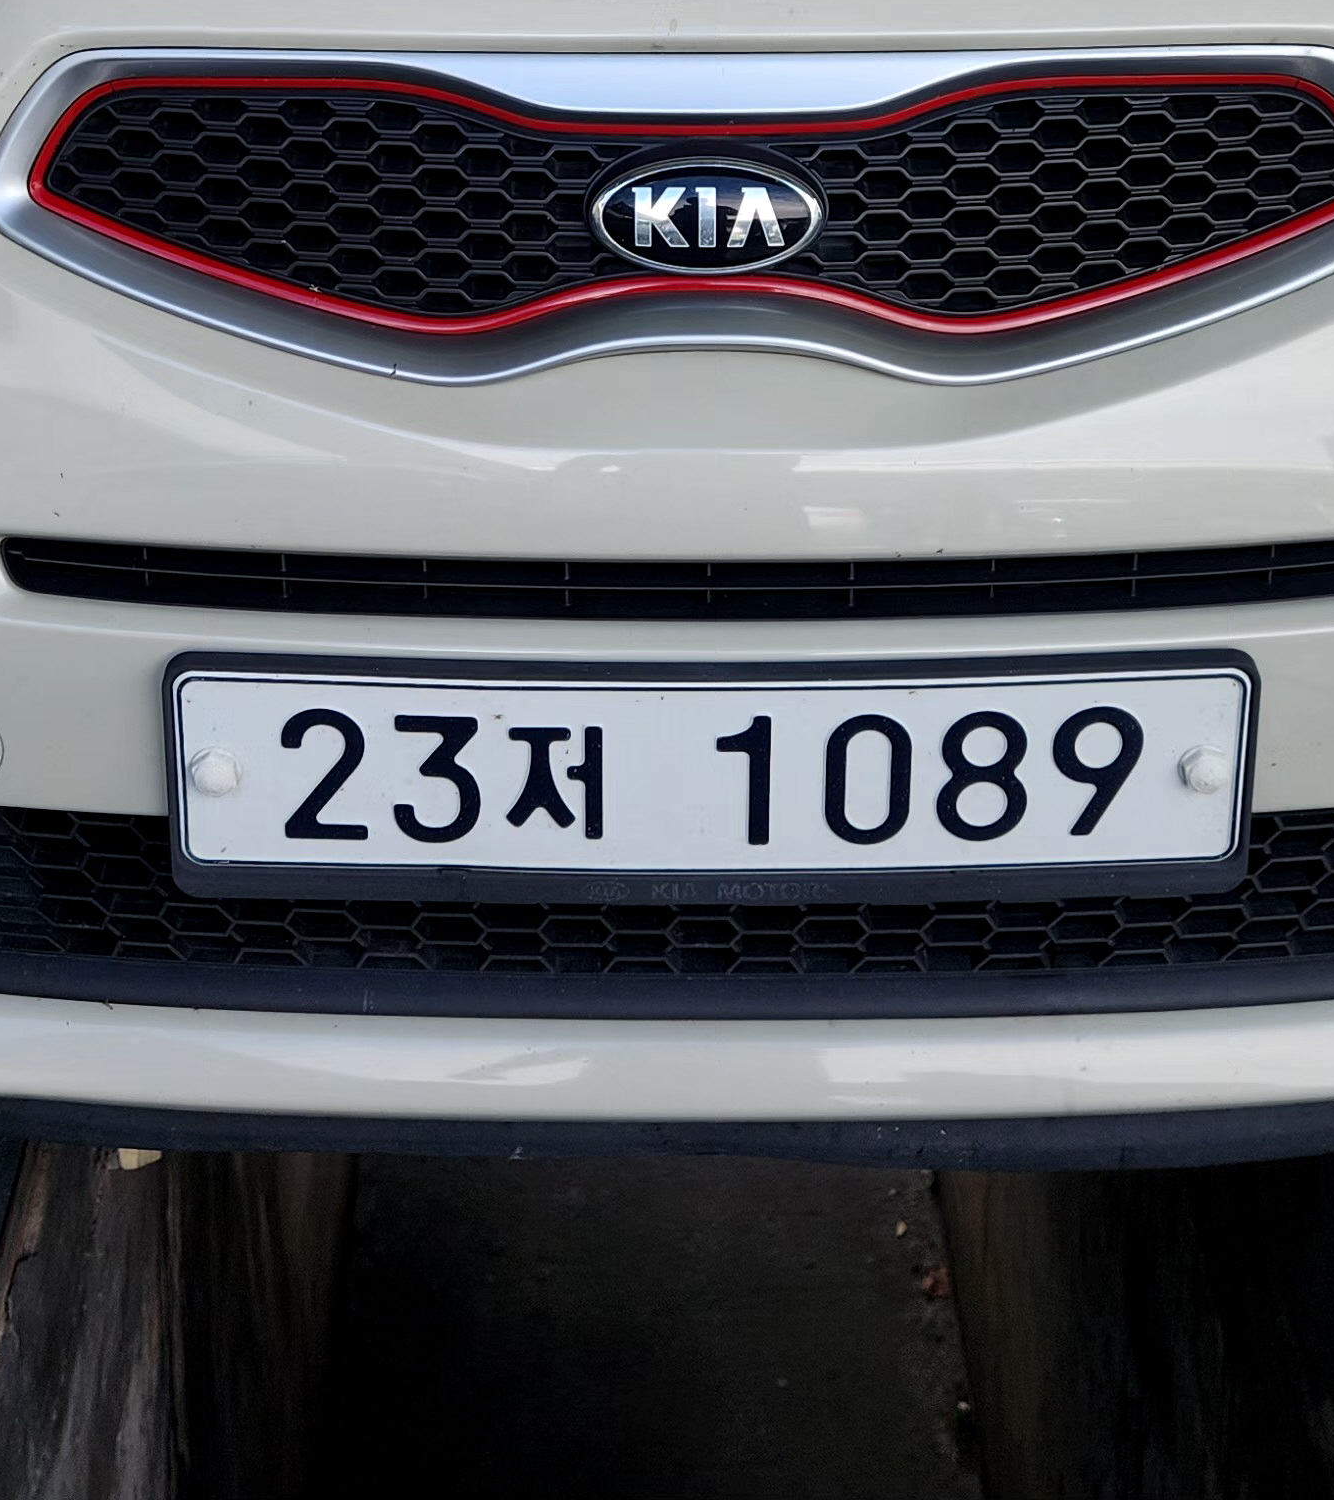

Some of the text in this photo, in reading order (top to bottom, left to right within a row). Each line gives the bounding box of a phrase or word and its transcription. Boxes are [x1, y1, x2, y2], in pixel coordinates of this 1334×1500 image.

[631, 186, 786, 248] KIA
[279, 705, 1145, 847] 23저 1089
